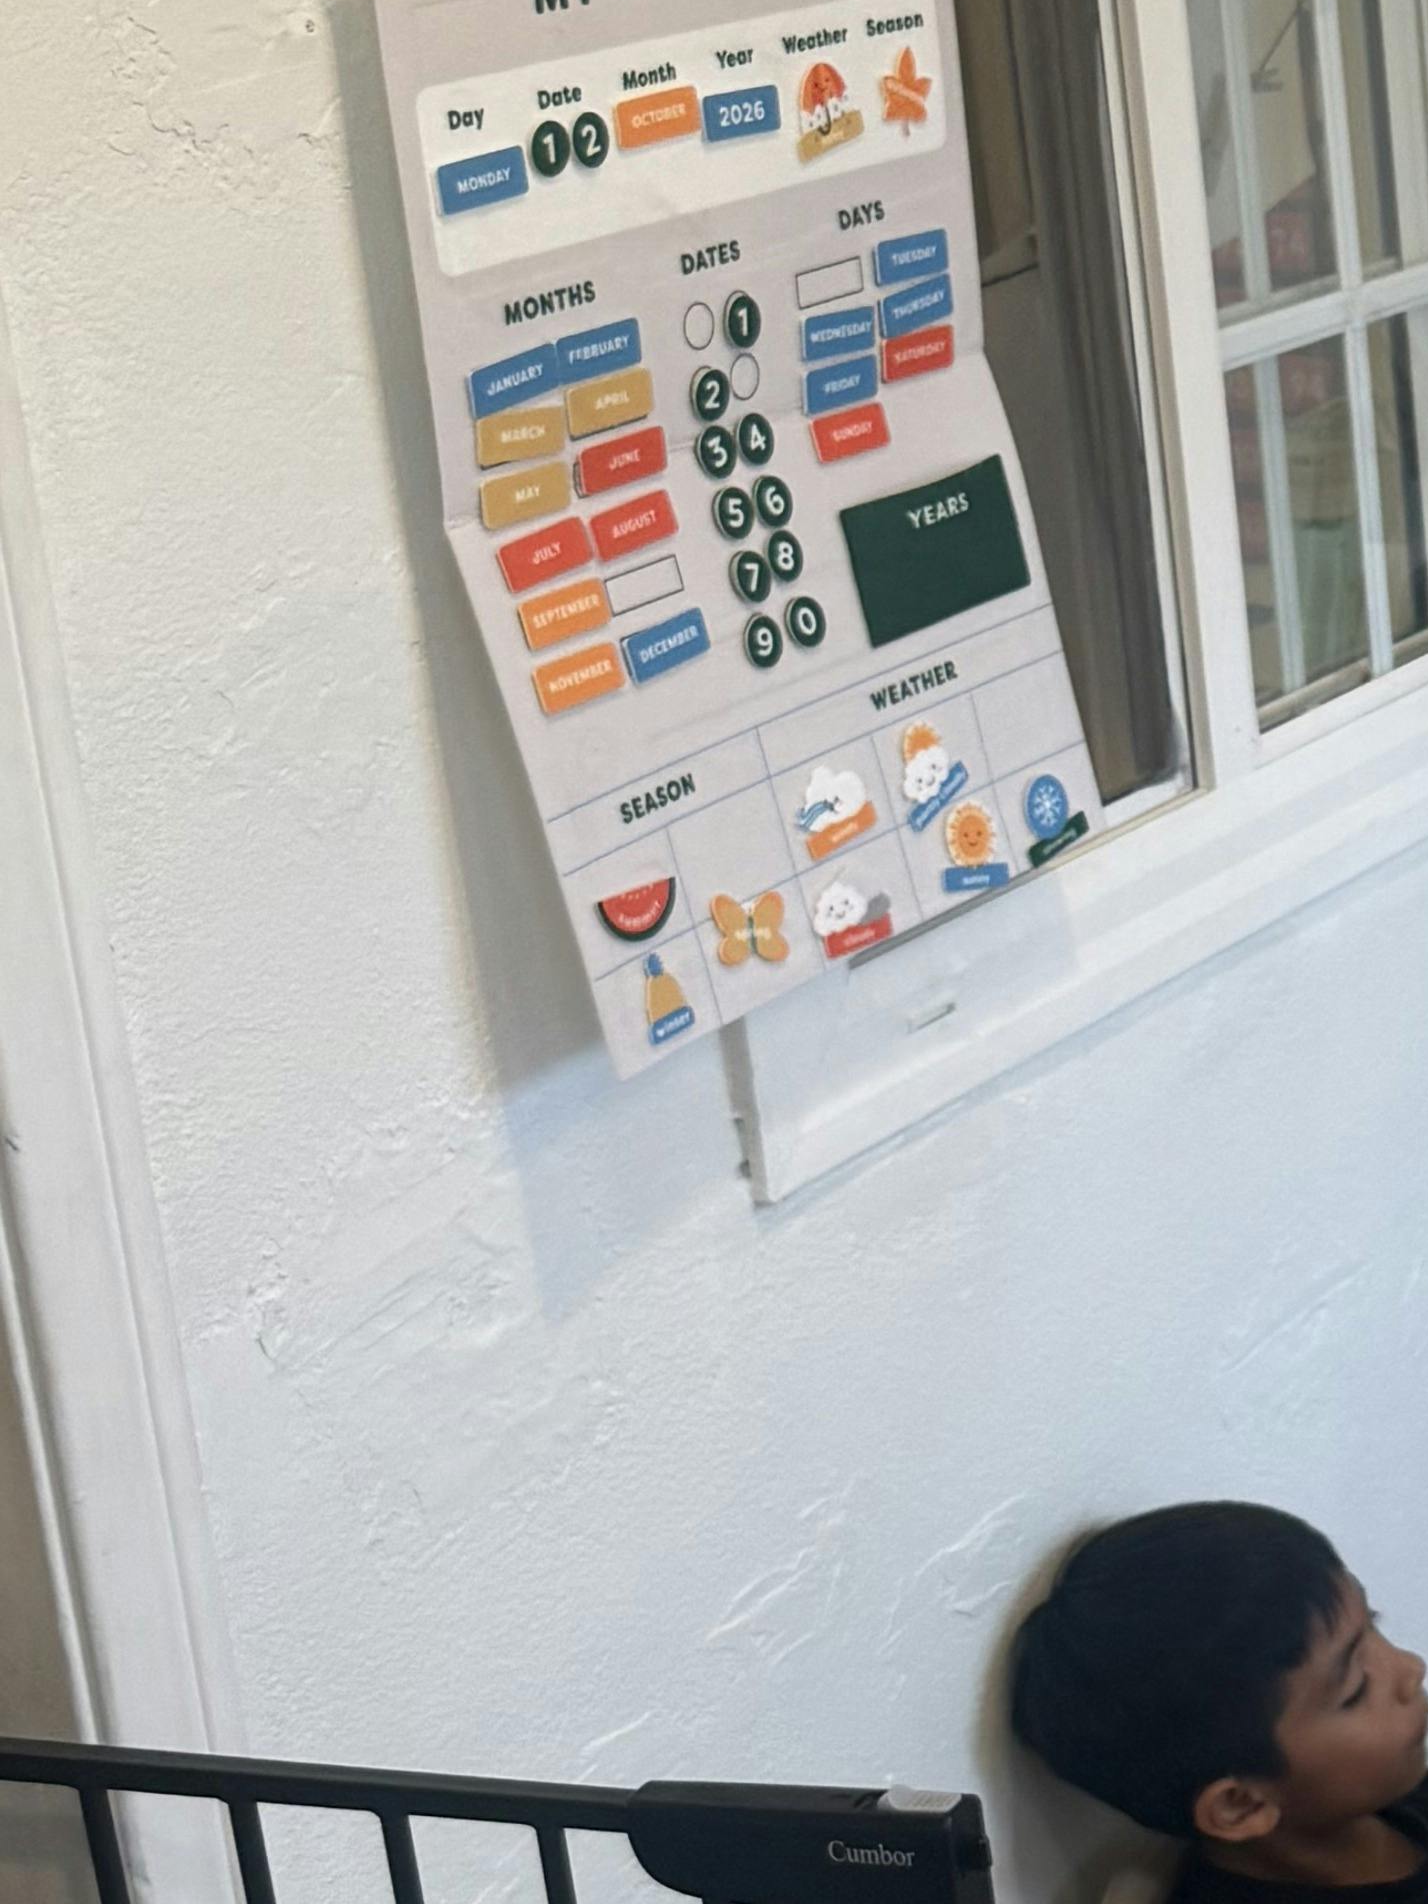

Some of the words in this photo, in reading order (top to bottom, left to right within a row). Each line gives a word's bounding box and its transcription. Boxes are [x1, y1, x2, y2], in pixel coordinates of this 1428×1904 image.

[865, 11, 925, 40] Season
[781, 26, 849, 57] Weather
[715, 46, 755, 71] Year
[622, 62, 677, 92] Month
[536, 84, 583, 111] Date
[447, 107, 486, 134] Day
[718, 100, 767, 130] 2026
[456, 167, 512, 196] MONDAY
[838, 200, 886, 232] DAYS
[680, 241, 742, 275] DATES
[504, 281, 597, 326] MONTHS
[737, 308, 750, 338] 1
[568, 333, 630, 365] FEBRUARY
[486, 362, 545, 397] JANUARY
[704, 380, 722, 410] 2
[707, 437, 729, 468] 3
[748, 424, 767, 453] 4
[608, 448, 642, 472] JUNE
[514, 484, 541, 503] MAY
[765, 486, 786, 516] 6
[611, 508, 658, 540] AUGUST
[727, 498, 745, 529] 5
[906, 492, 970, 529] YEARS
[531, 541, 562, 566] JULY
[776, 543, 794, 572] 8
[744, 562, 760, 593] 7
[530, 592, 600, 630] SEPTEMBER
[638, 623, 699, 664] DECEMBER
[755, 626, 774, 657] 9
[548, 659, 613, 693] NOVEMBER
[870, 660, 958, 712] WEATHER
[619, 773, 696, 824] SEASON
[827, 1840, 916, 1867] Cumbor
